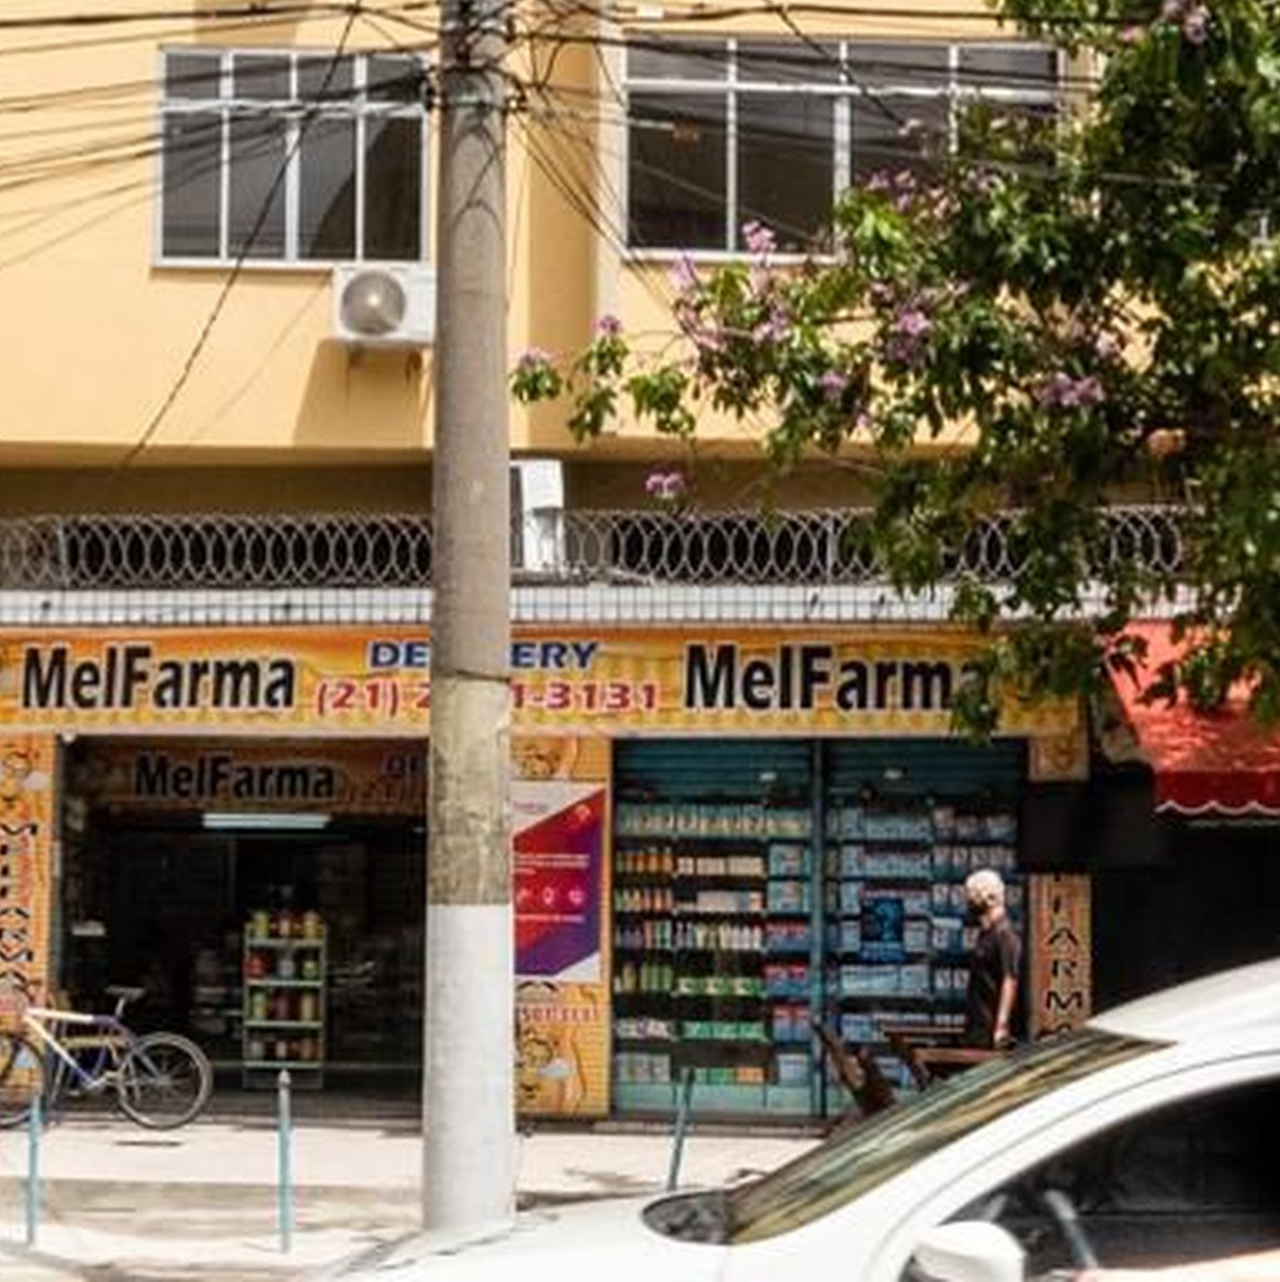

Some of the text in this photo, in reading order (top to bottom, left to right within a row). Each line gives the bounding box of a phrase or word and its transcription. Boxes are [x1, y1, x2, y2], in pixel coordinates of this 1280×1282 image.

[371, 643, 598, 668] DEERY
[23, 646, 295, 709] MelFarma
[316, 681, 657, 715] (21) 21-3131
[134, 756, 334, 799] MelFarma
